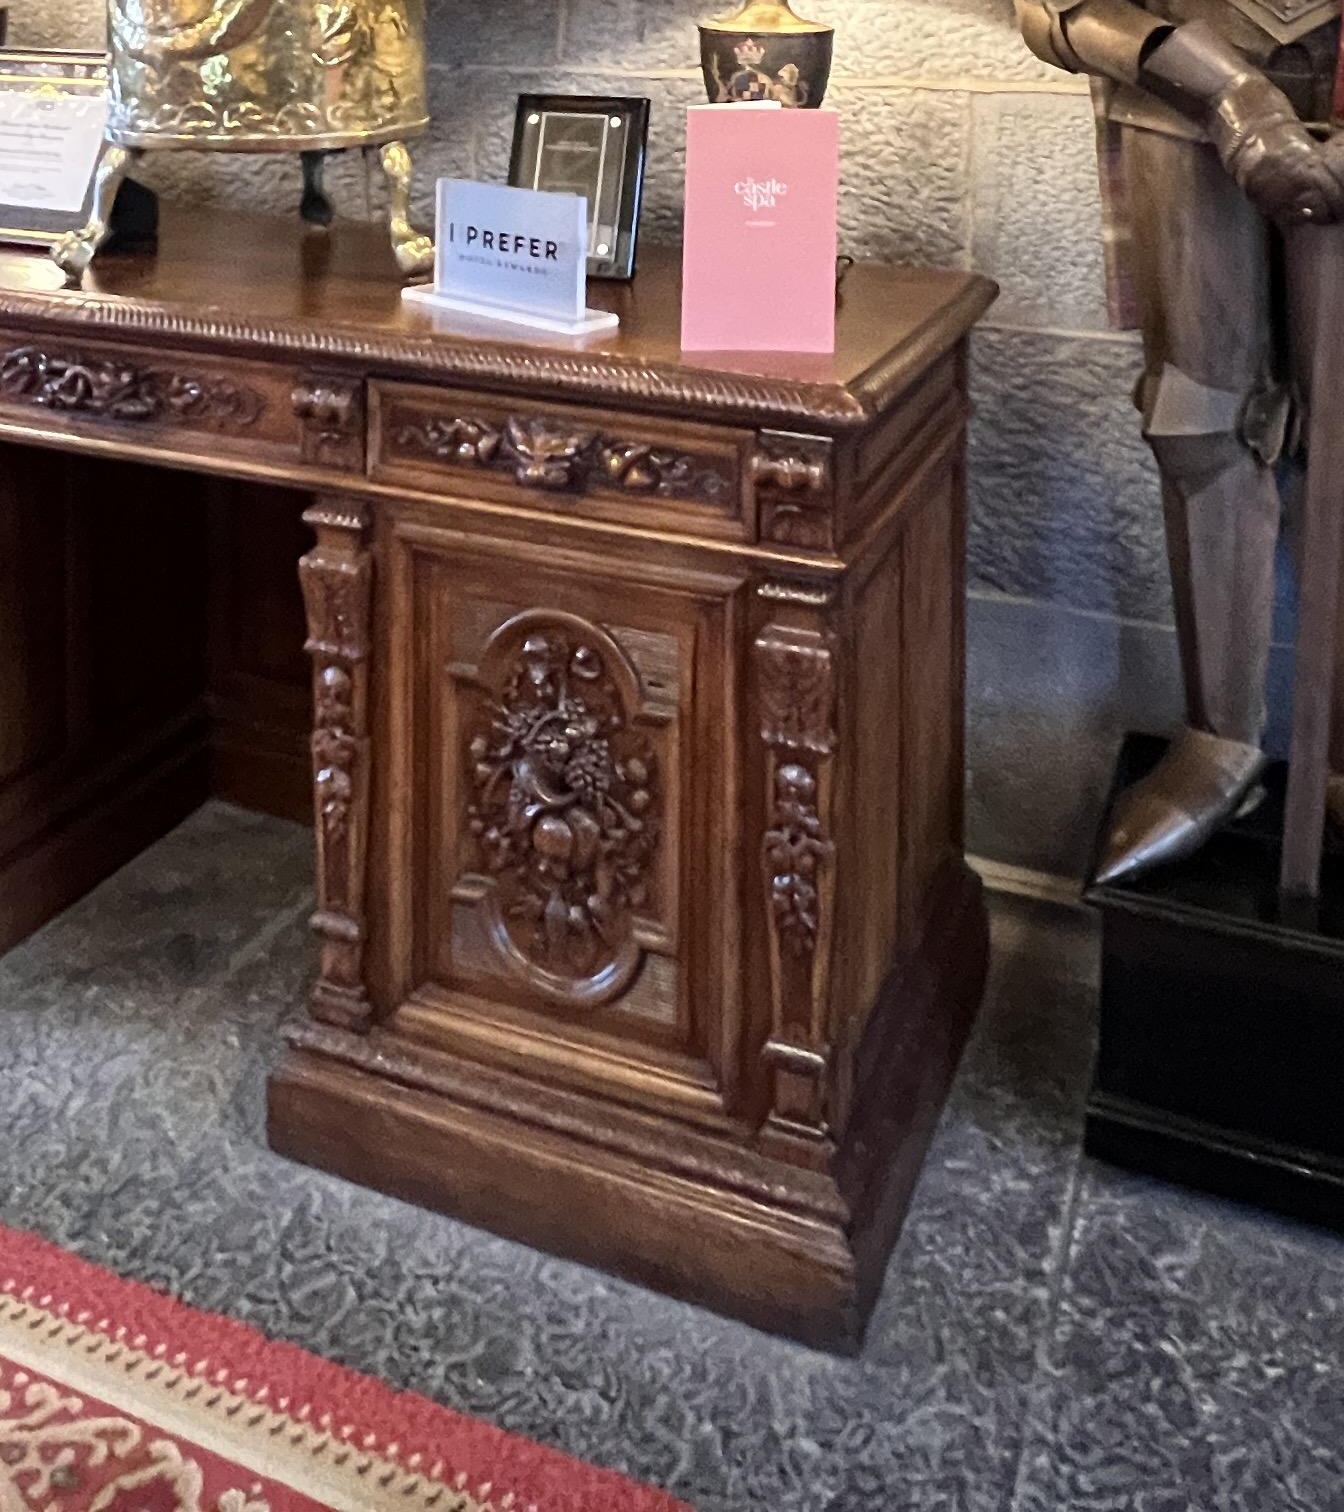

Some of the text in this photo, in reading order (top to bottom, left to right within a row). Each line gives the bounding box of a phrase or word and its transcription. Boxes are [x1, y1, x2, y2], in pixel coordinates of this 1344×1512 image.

[743, 192, 776, 212] spa
[449, 222, 558, 261] I PREFER
